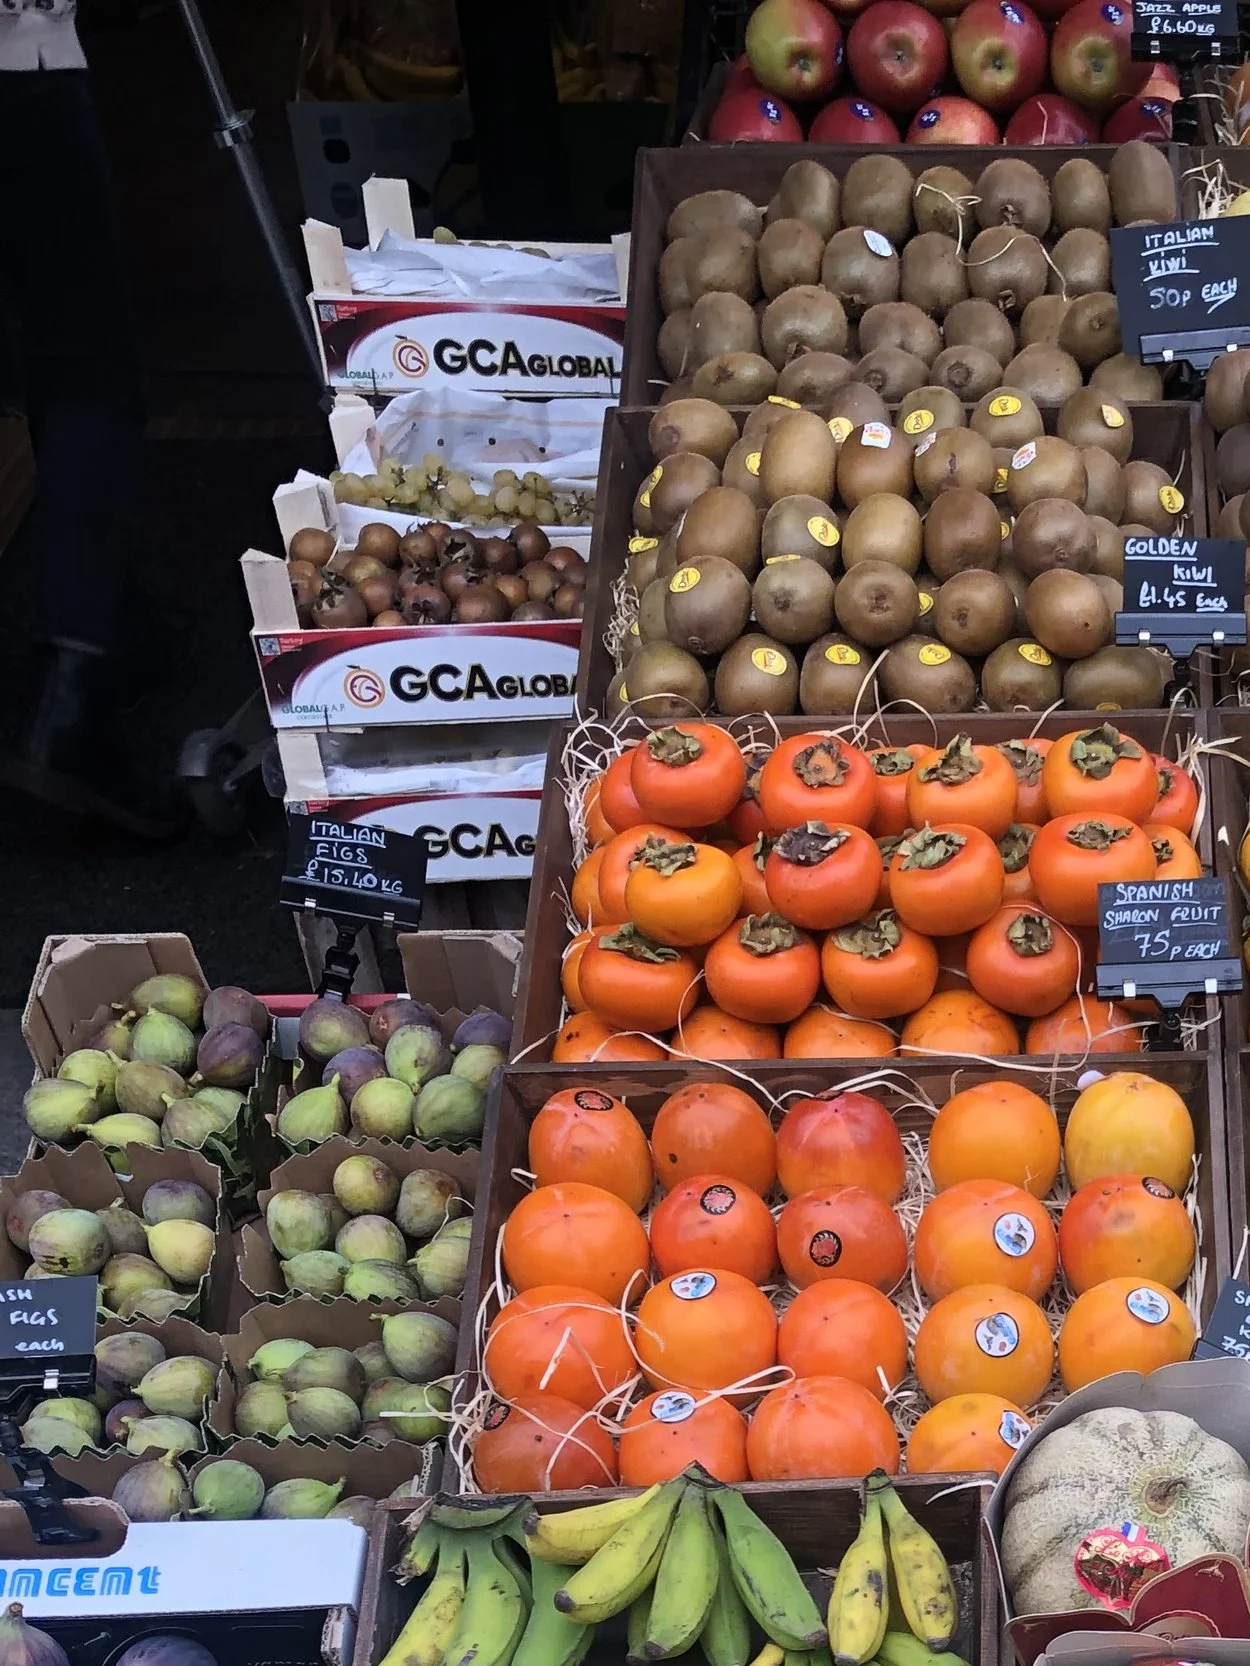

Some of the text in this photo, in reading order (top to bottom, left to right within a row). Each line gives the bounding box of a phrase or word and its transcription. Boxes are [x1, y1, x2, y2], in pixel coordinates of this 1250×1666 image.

[1136, 2, 1222, 13] JAZZ APPLE
[1201, 277, 1238, 300] EACH
[1125, 538, 1198, 556] GOLDEN
[1139, 581, 1187, 608] £1.45
[311, 820, 386, 845] ITALIAN
[1115, 882, 1194, 903] SPANISH
[1103, 906, 1222, 929] SHARON FRUIT
[1185, 940, 1221, 959] EACH
[10, 1308, 59, 1325] FIGS
[15, 1338, 64, 1351] each
